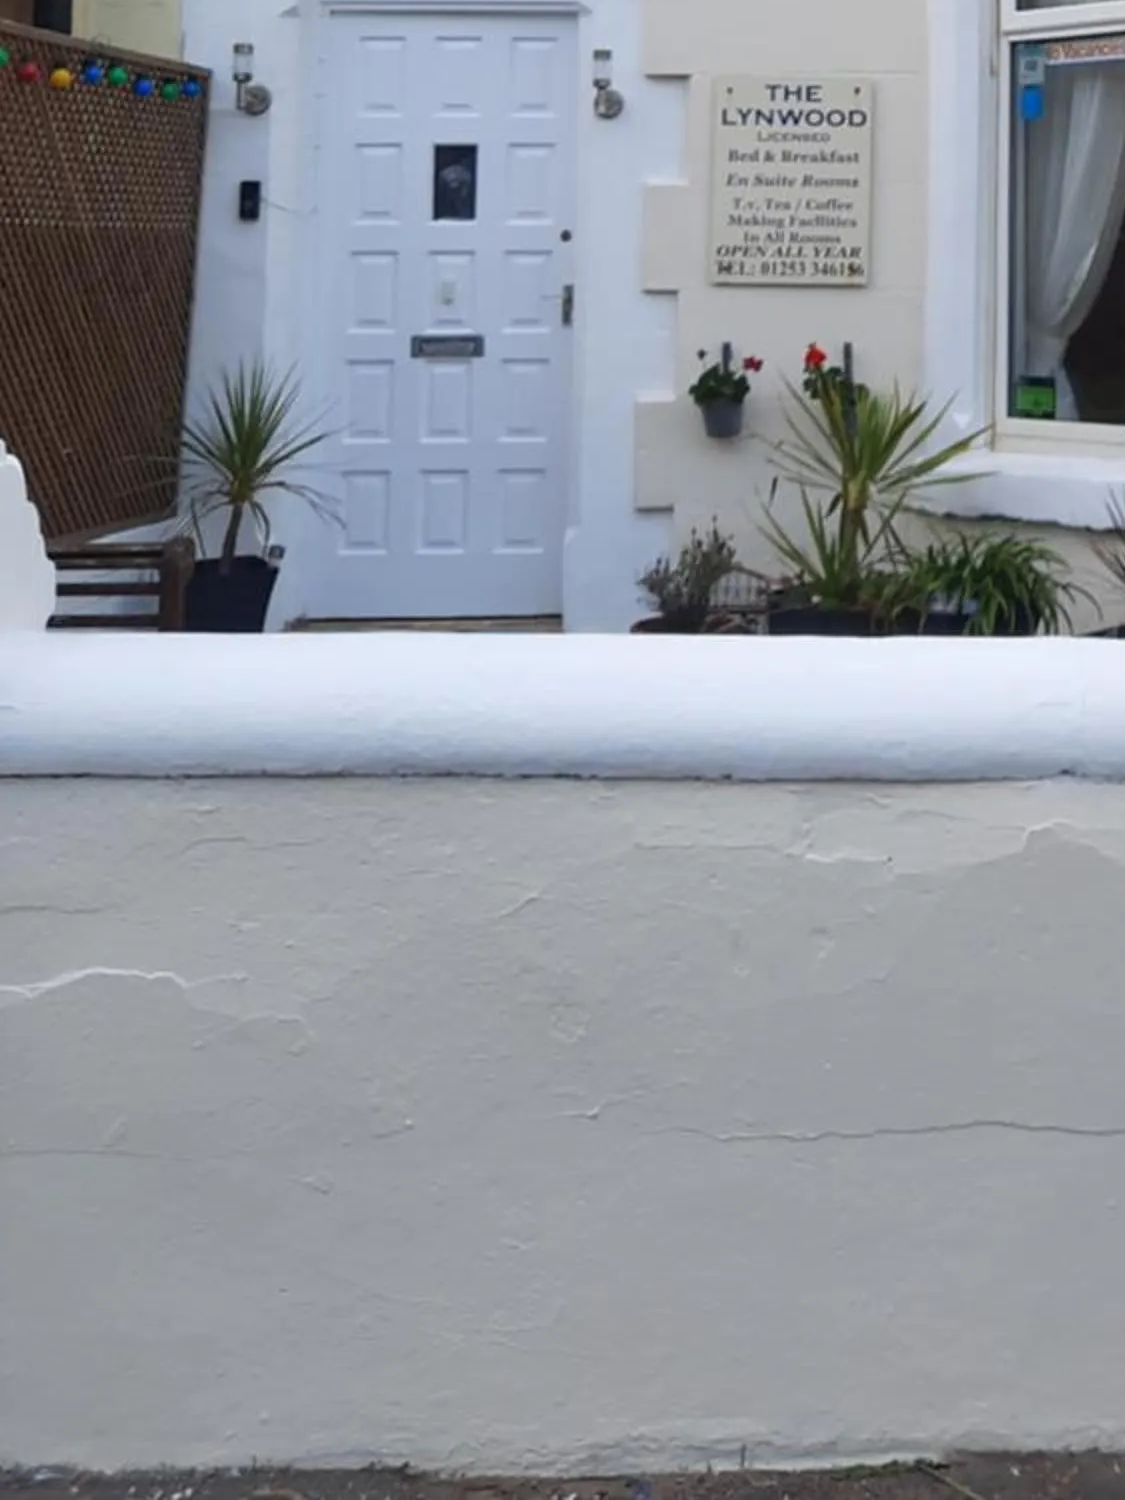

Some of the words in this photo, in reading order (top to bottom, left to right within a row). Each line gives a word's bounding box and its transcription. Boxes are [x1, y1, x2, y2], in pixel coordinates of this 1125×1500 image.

[765, 84, 823, 102] THE
[721, 108, 868, 127] LYNWOOD
[728, 149, 760, 163] Bed
[763, 151, 776, 164] &
[781, 149, 860, 164] Breakfast
[726, 173, 749, 187] En
[752, 173, 798, 187] Suite
[801, 174, 860, 188] Rooms
[804, 198, 853, 211] Coffee
[727, 214, 785, 229] Making
[788, 214, 858, 228] Facilities
[789, 232, 841, 244] Rooms
[715, 245, 767, 258] OPEN
[770, 245, 808, 258] ALL
[813, 245, 862, 259] YEAR
